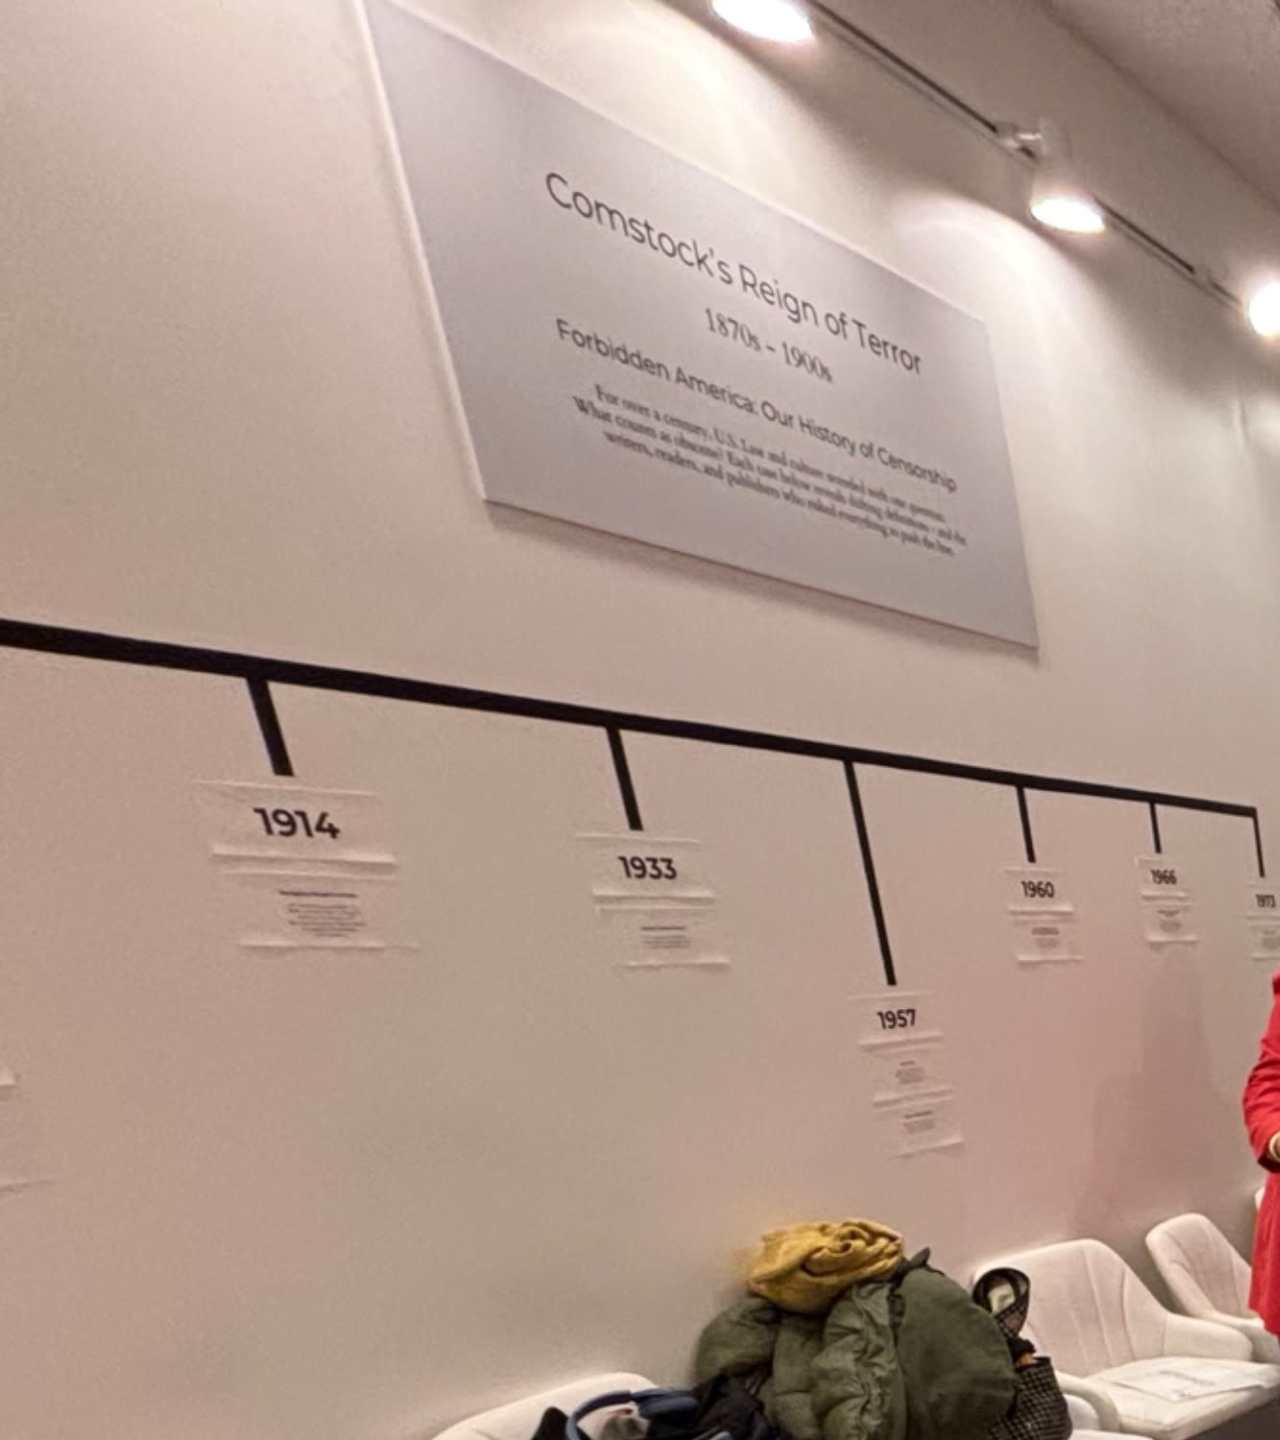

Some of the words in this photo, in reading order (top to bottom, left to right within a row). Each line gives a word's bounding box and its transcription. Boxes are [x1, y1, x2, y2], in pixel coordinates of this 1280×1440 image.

[545, 172, 733, 285] Comstock's
[739, 263, 819, 327] Reign
[824, 312, 848, 340] of
[852, 318, 921, 374] Terror
[705, 307, 761, 352] 1870s
[782, 341, 833, 382] 1900s
[556, 318, 671, 381] Forbidden
[761, 401, 793, 428] Our
[799, 415, 855, 457] History
[860, 442, 875, 459] of
[877, 447, 957, 494] Censorship
[253, 807, 341, 839] 1914
[618, 856, 677, 879] 1933
[1150, 869, 1178, 885] 1966
[1021, 880, 1055, 899] 1960
[877, 1008, 916, 1030] 1957
